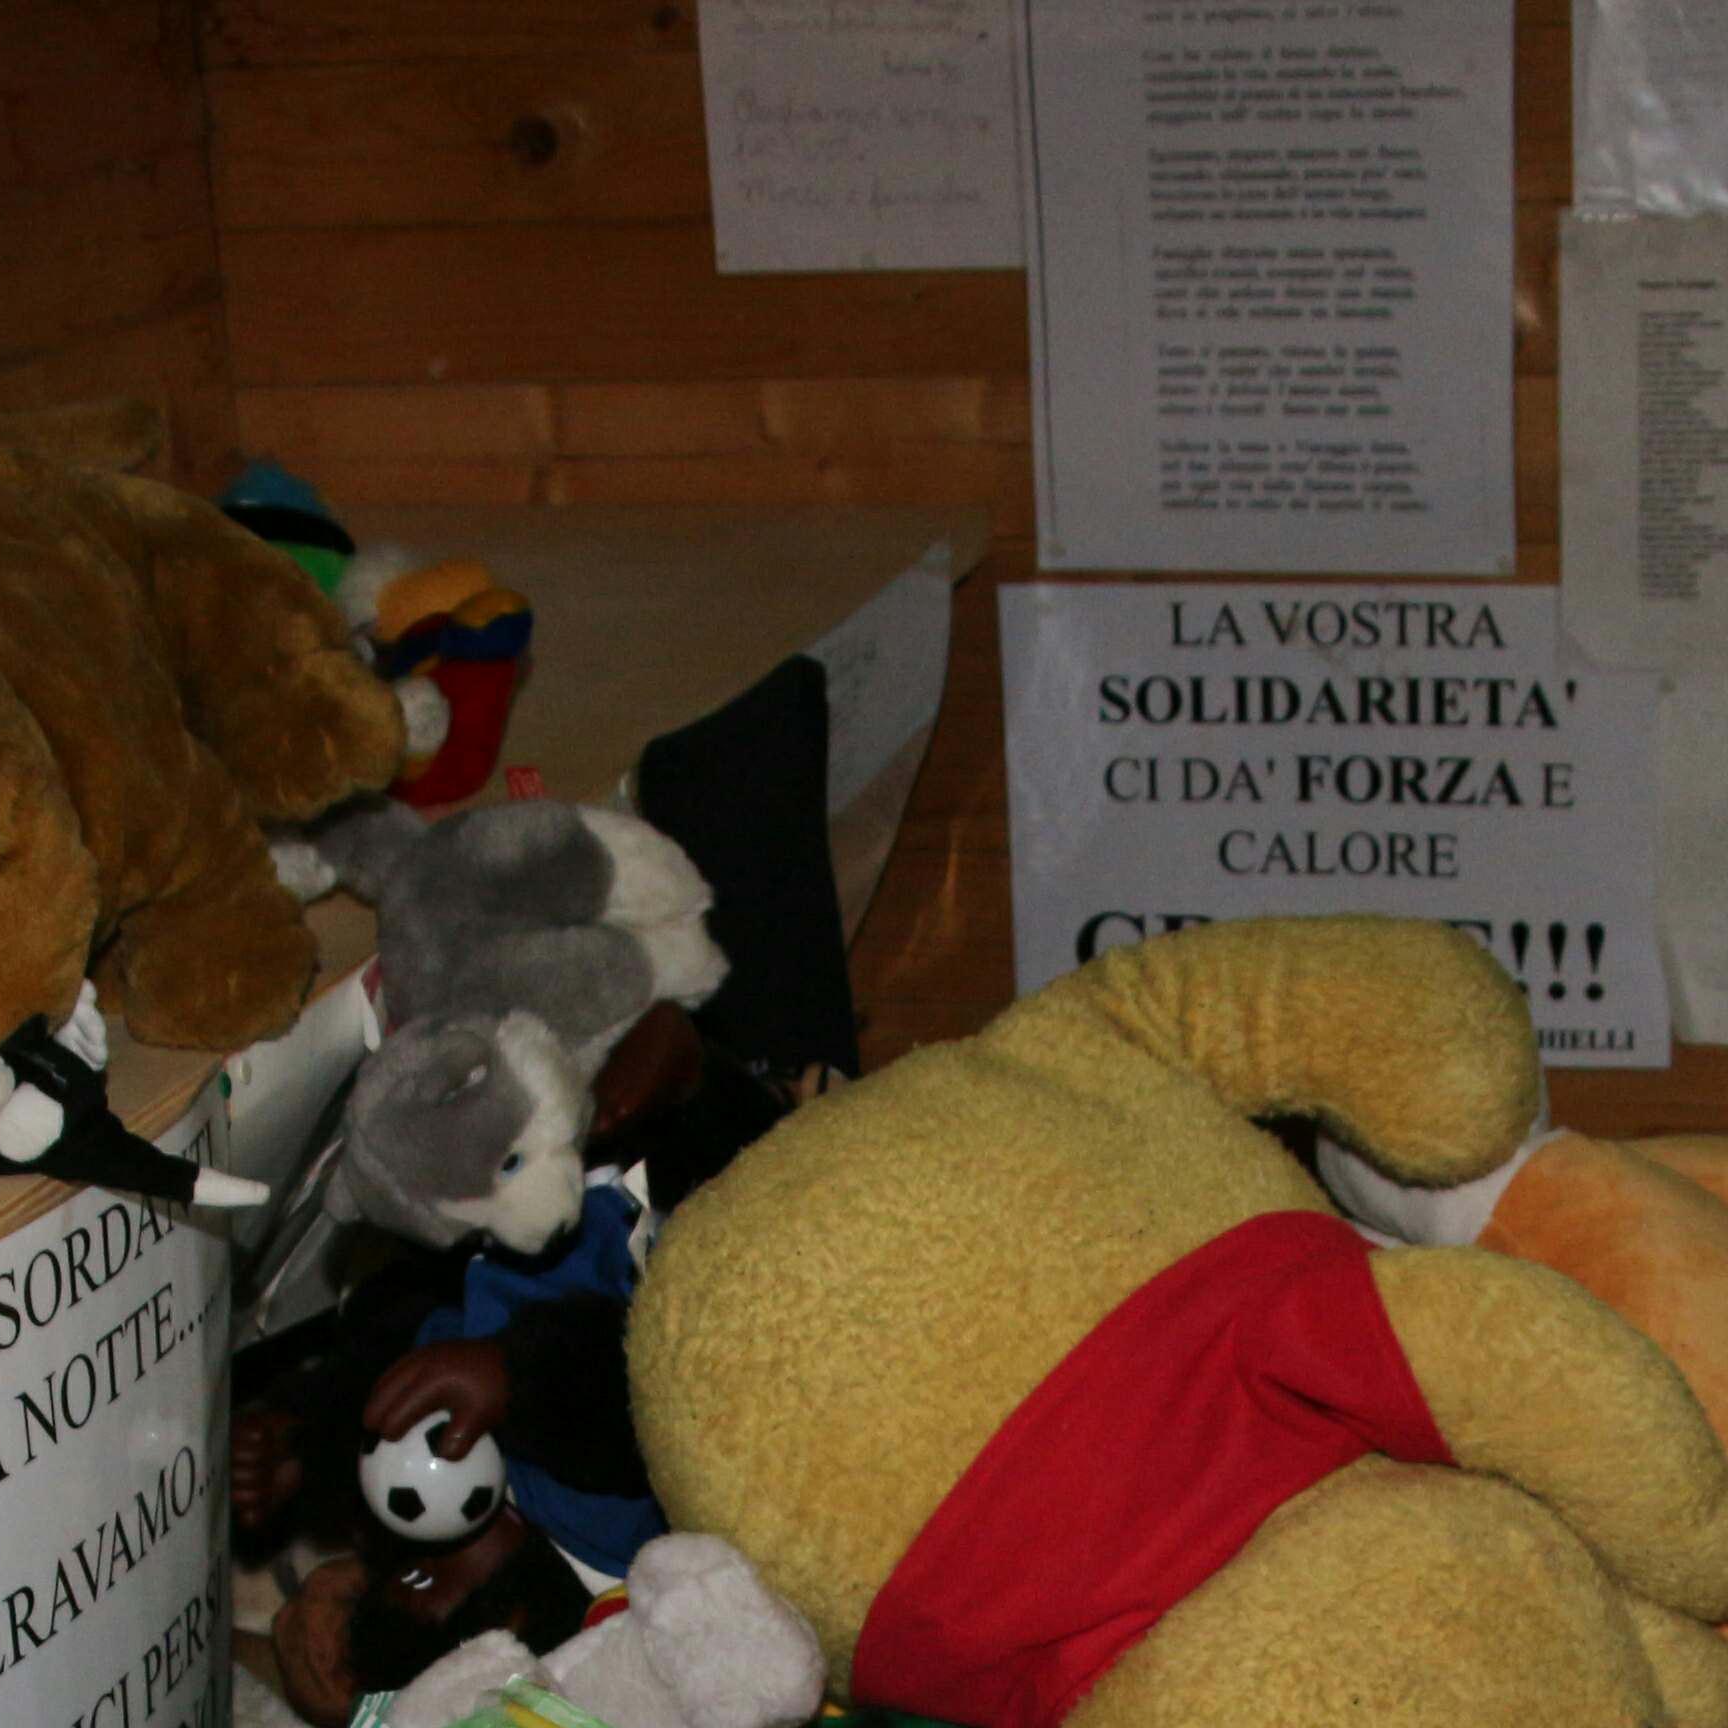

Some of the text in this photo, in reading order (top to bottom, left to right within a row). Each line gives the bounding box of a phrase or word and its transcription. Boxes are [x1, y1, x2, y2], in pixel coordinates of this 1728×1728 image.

[1171, 601, 1505, 650] LA VOSTRA
[1098, 675, 1577, 729] SOLIDARIETA'
[1104, 754, 1575, 809] CI DA' FORZA E
[1217, 830, 1459, 879] CALORE
